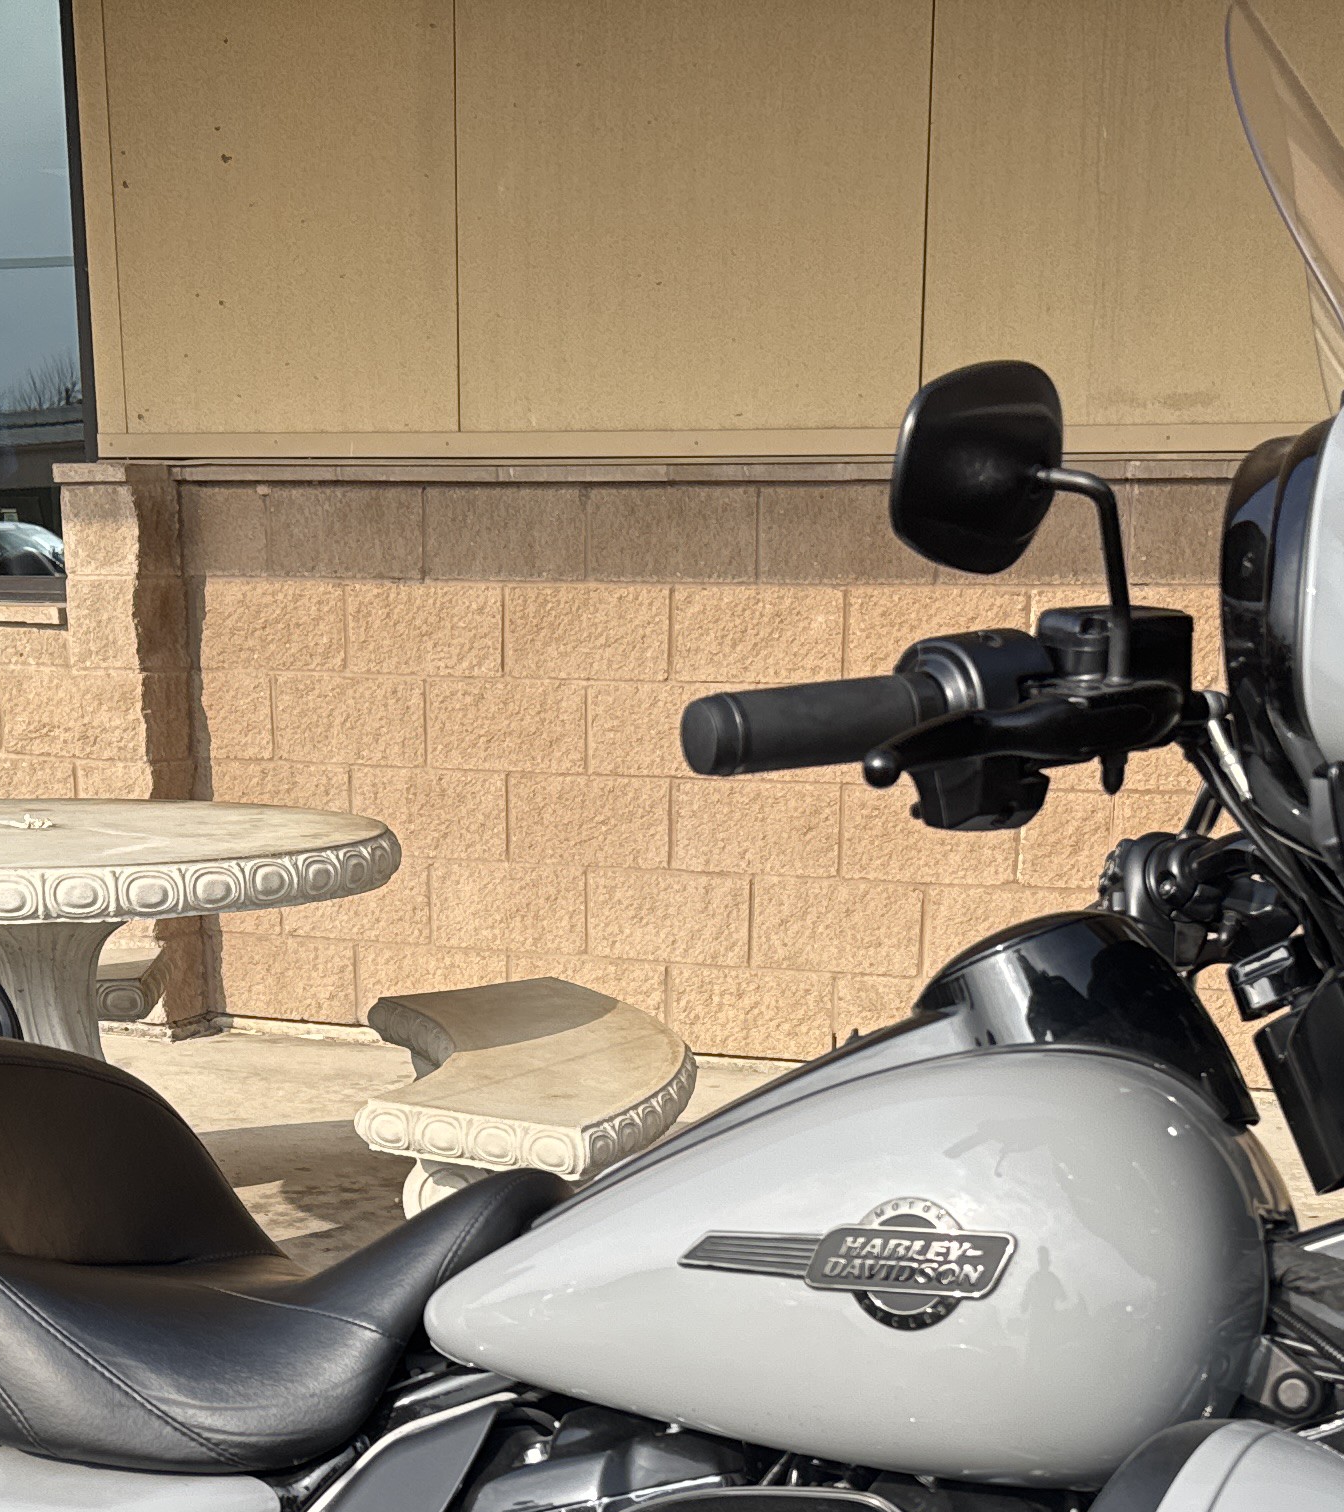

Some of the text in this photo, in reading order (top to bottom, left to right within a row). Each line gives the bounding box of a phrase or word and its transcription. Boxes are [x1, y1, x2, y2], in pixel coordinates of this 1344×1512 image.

[874, 1201, 945, 1221] MOTOR
[837, 1237, 985, 1261] HARLEY-
[822, 1258, 985, 1286] DAVIDSON
